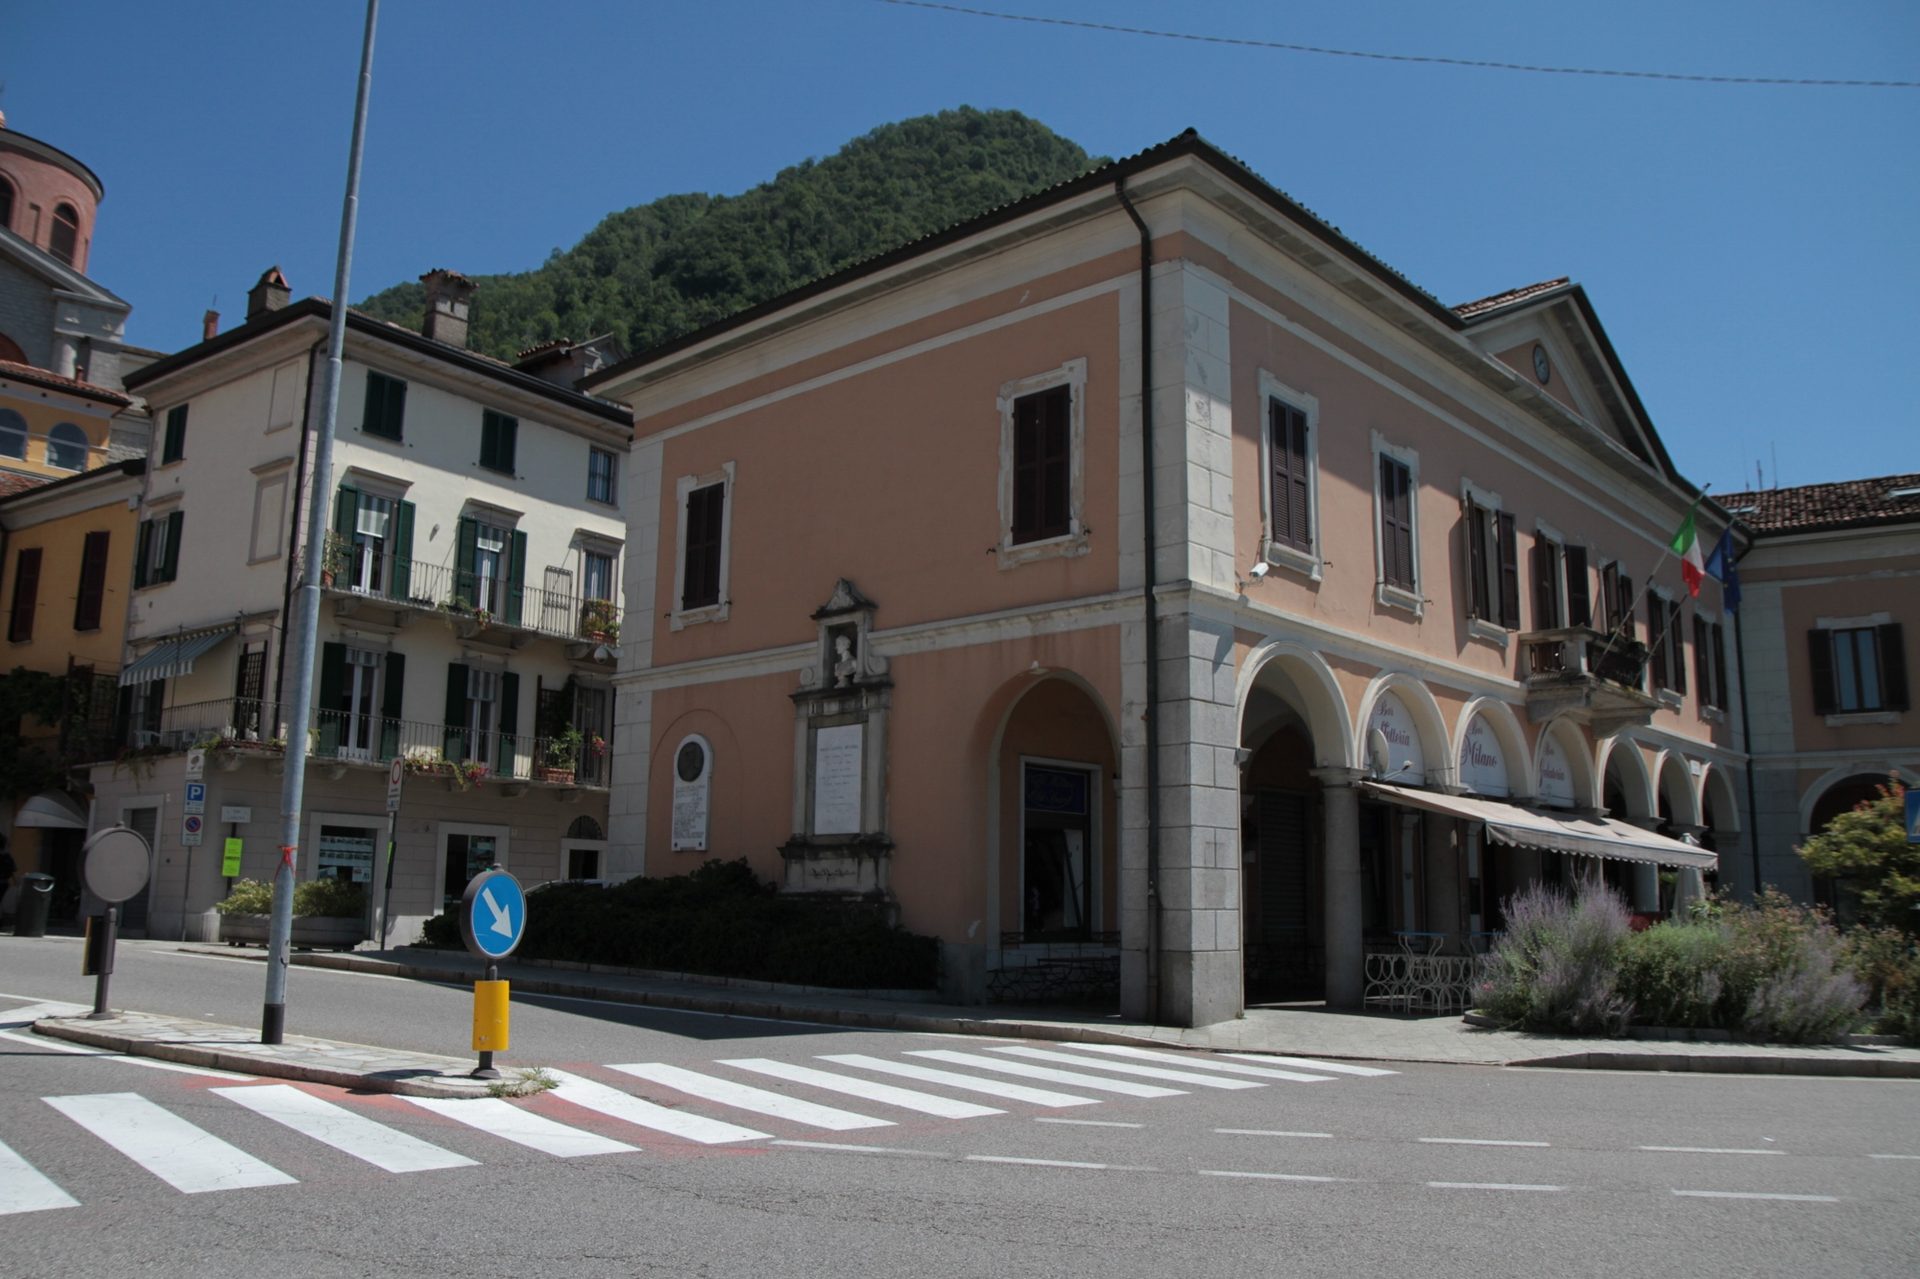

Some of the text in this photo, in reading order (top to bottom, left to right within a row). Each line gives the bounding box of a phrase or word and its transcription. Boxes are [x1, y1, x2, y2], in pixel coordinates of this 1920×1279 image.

[1376, 699, 1395, 717] Bar
[1466, 718, 1484, 736] Bar
[1460, 734, 1498, 769] Milano
[190, 786, 202, 799] P
